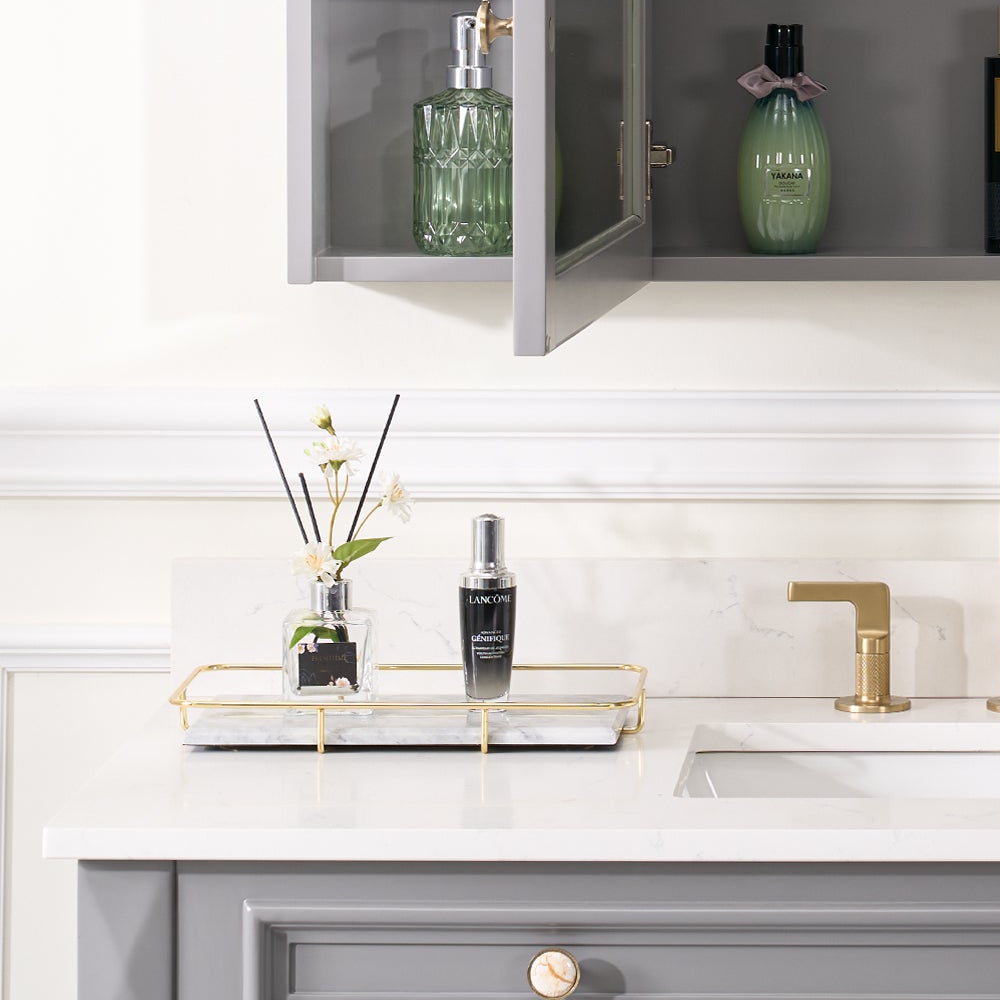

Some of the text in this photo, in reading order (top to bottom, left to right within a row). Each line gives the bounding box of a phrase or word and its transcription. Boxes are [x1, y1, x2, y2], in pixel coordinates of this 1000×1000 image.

[770, 172, 804, 180] YAKANA
[469, 593, 512, 605] LANCÔME
[471, 633, 510, 643] GÉNIFIQUE
